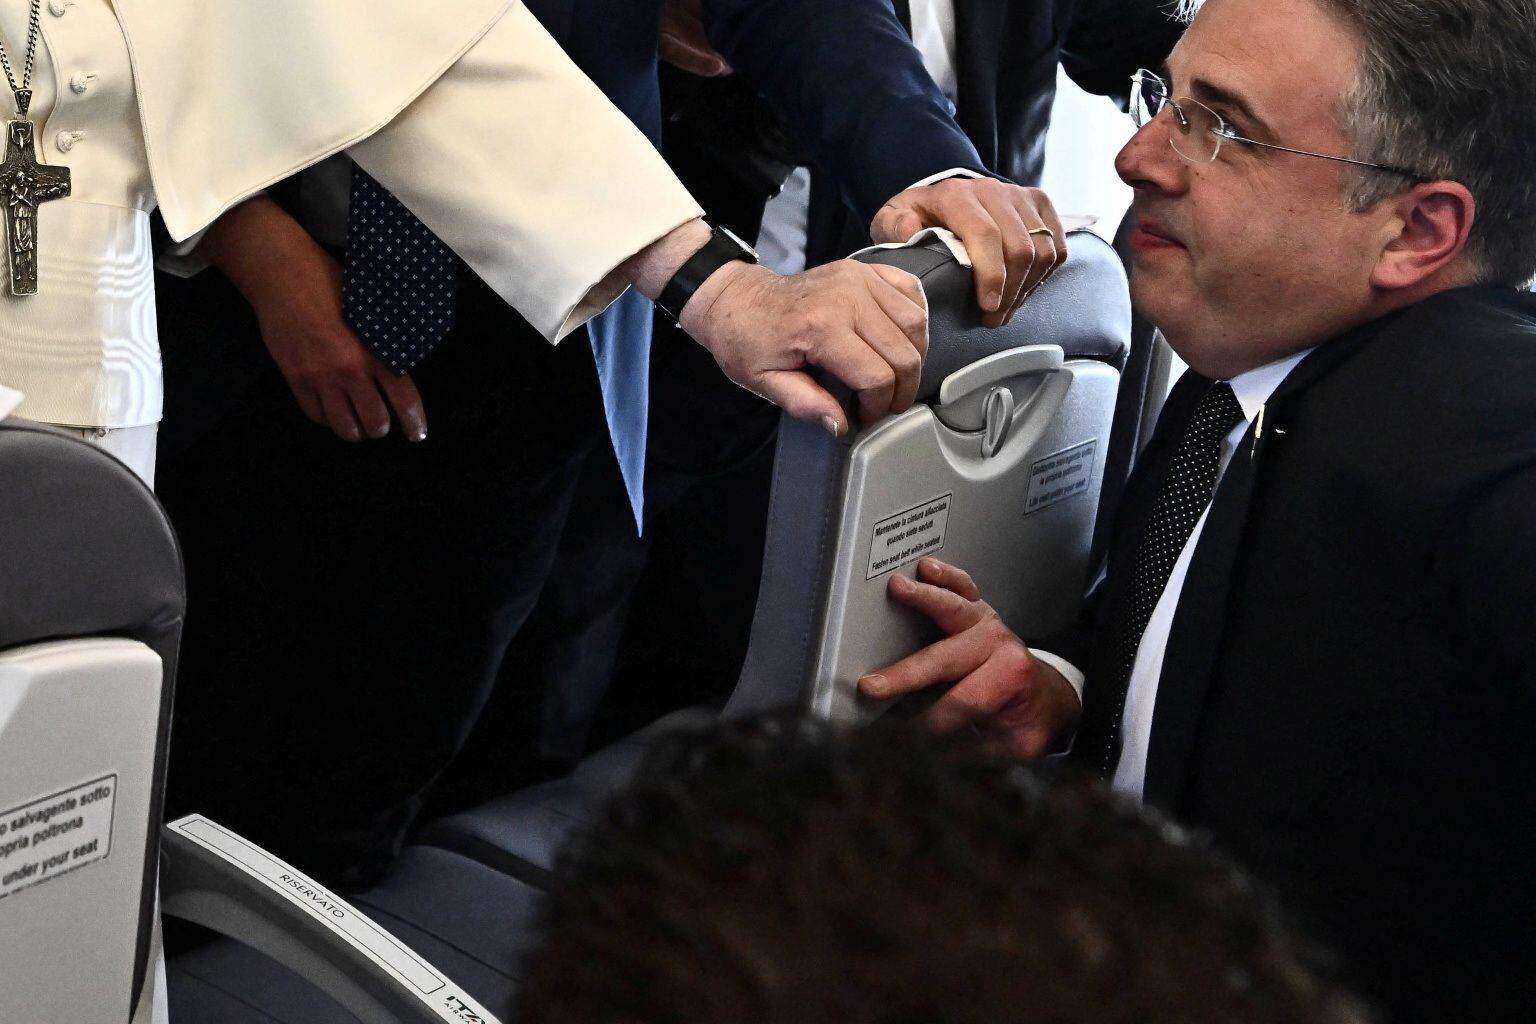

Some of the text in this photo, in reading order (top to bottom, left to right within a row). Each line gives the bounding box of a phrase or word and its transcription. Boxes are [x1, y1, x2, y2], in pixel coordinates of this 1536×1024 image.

[872, 558, 889, 571] Fasten
[889, 552, 900, 563] seat
[901, 549, 911, 559] belt
[80, 786, 111, 806] sotto
[33, 816, 84, 846] poltrona
[2, 862, 39, 886] under
[41, 851, 70, 875] your
[72, 838, 98, 859] seat
[280, 874, 345, 918] RISERVATO
